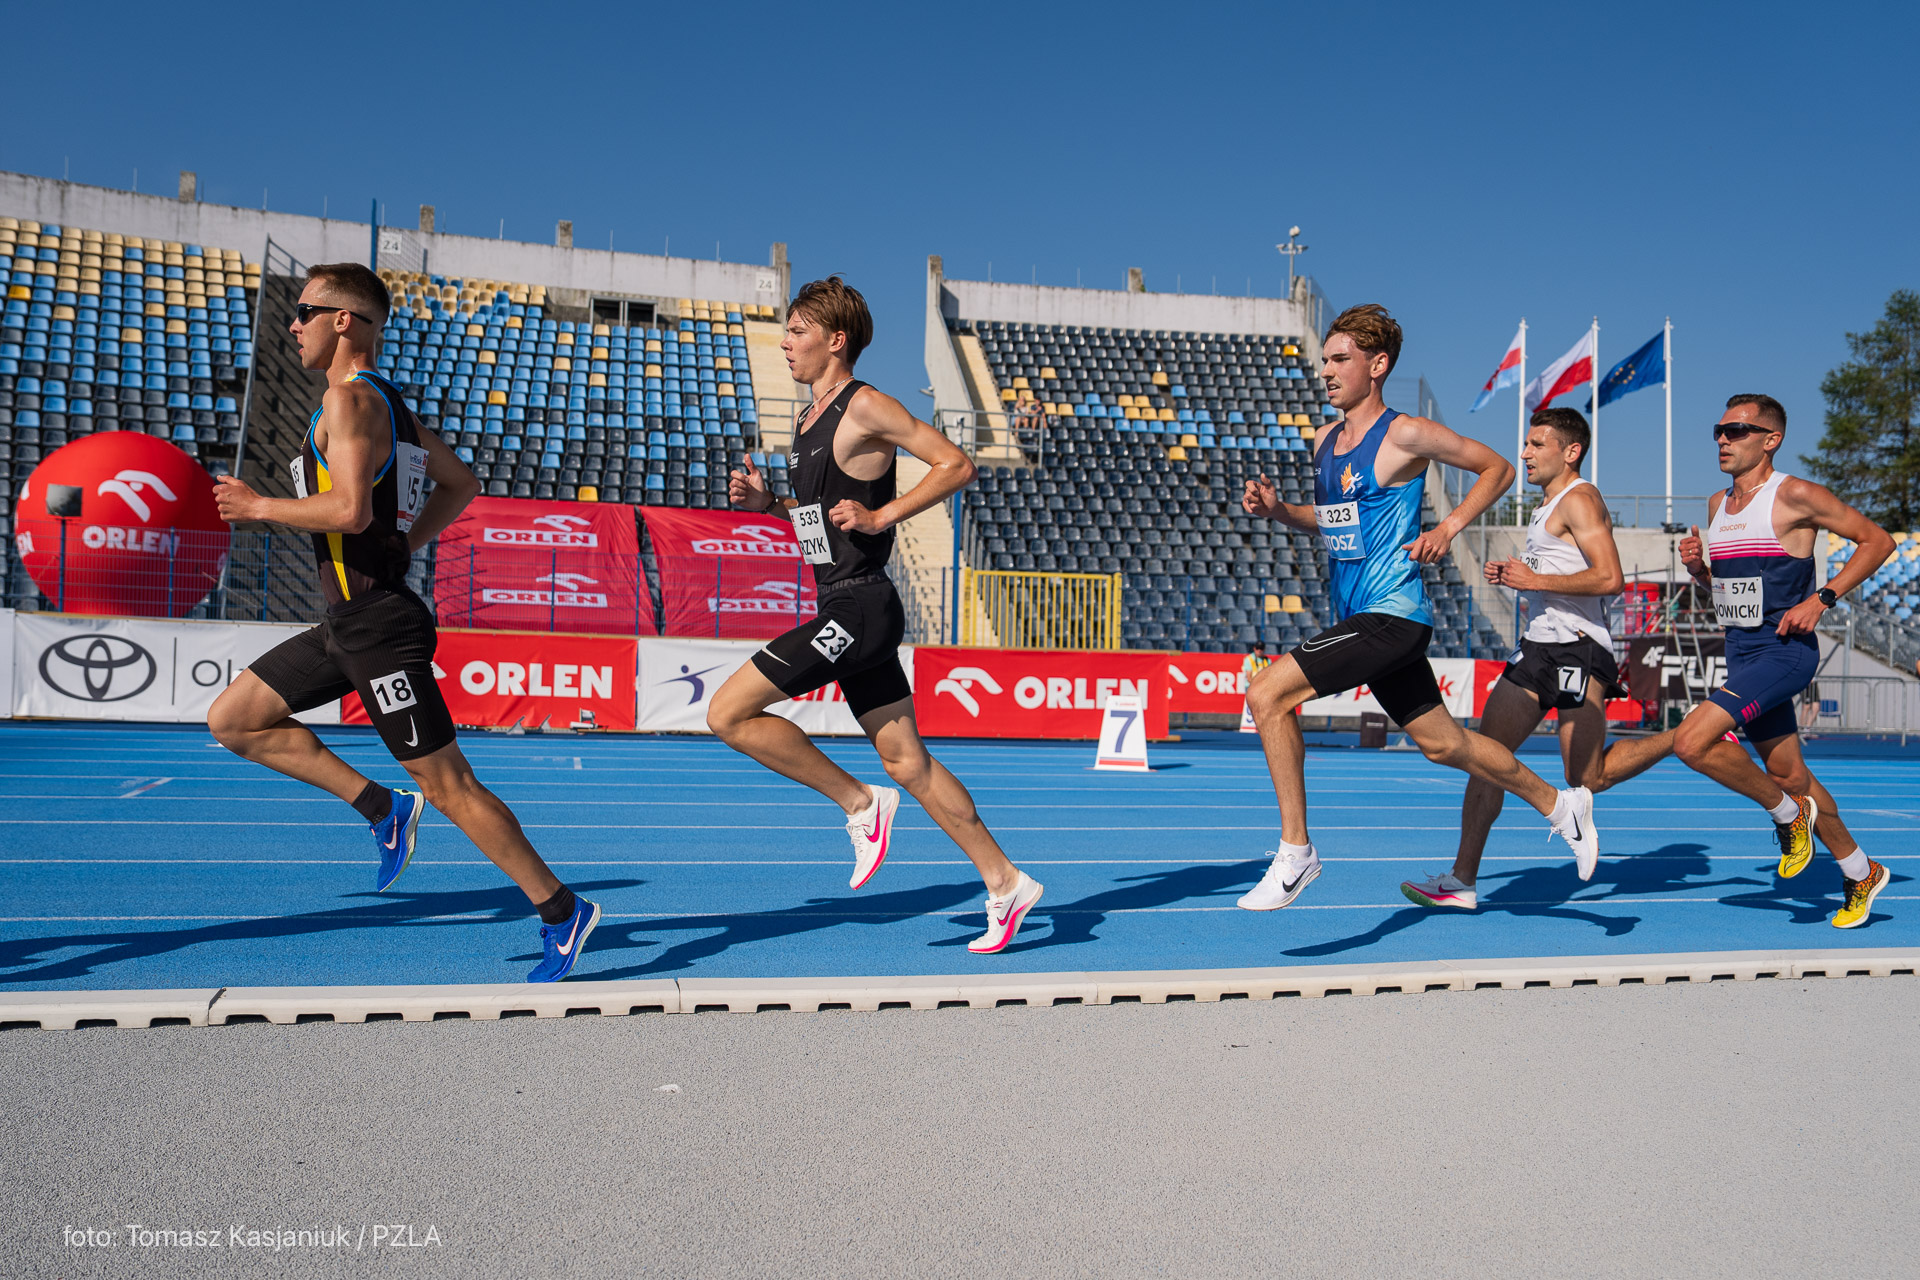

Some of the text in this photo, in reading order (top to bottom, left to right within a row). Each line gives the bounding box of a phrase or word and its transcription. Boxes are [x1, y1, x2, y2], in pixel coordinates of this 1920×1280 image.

[383, 240, 399, 251] 24
[758, 279, 772, 289] 24
[800, 510, 819, 527] 533
[1326, 508, 1352, 524] 323
[1719, 522, 1748, 533] saucony
[83, 526, 180, 555] ORLEN
[490, 531, 590, 544] ORLEN
[699, 542, 794, 555] ORLEN
[1525, 556, 1539, 570] 290
[1731, 581, 1757, 595] 574
[490, 592, 599, 605] ORLEN
[718, 600, 816, 612] ORLEN
[815, 626, 848, 656] 23
[1642, 646, 1665, 668] 4F
[460, 660, 613, 700] ORLEN
[1562, 668, 1575, 690] 7
[375, 678, 411, 707] 18
[1014, 676, 1149, 710] ORLEN
[1110, 710, 1138, 753] 7
